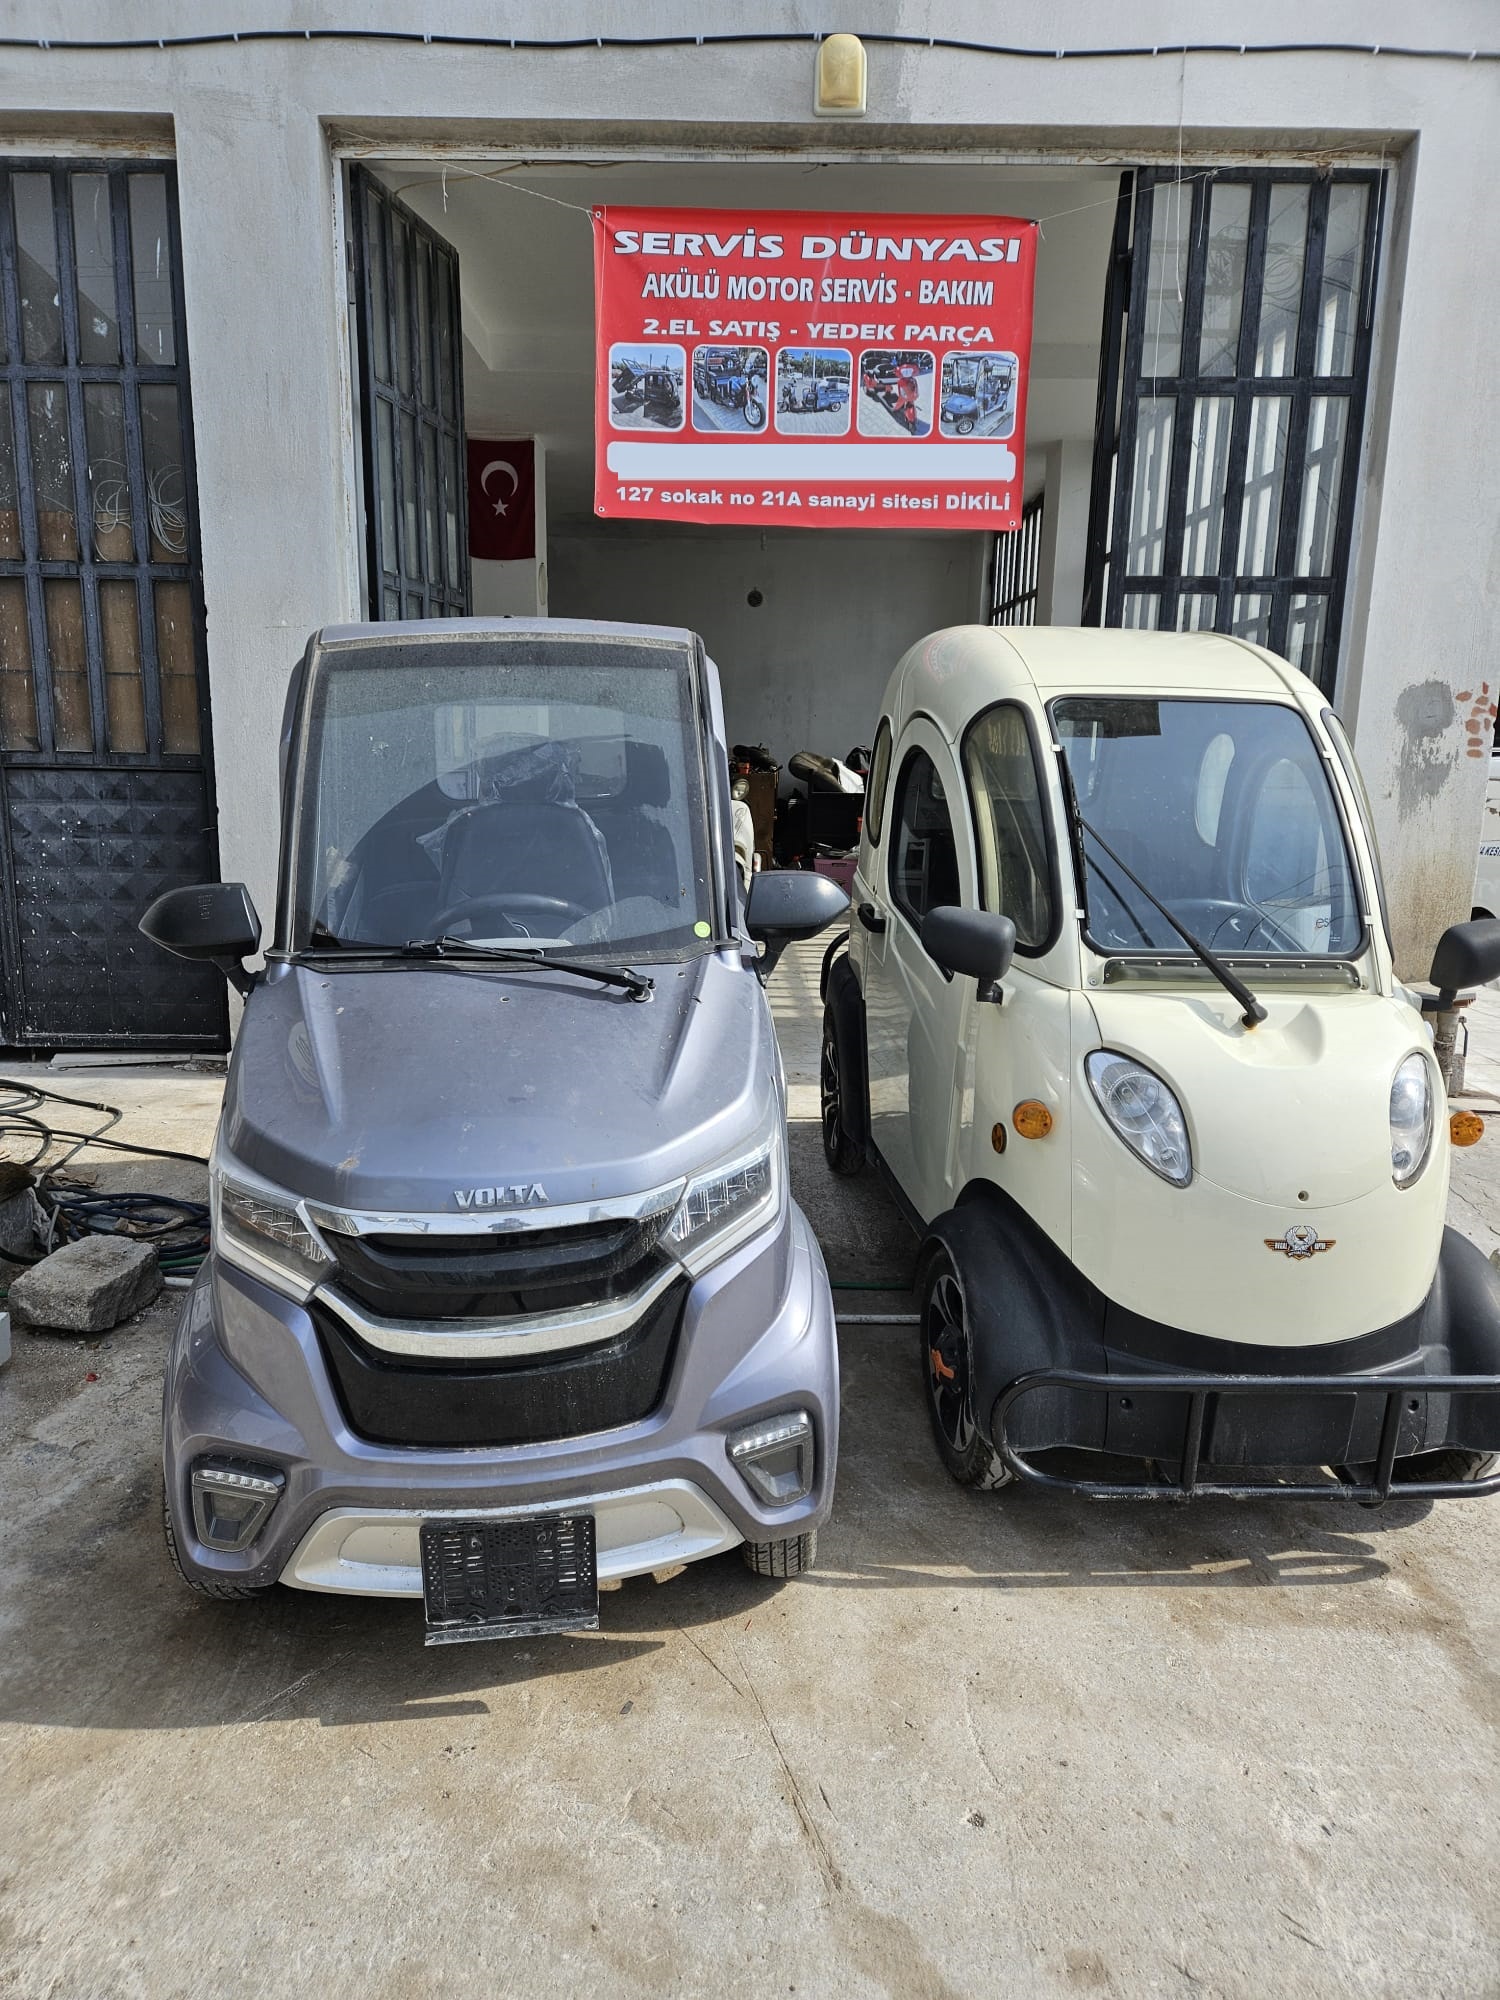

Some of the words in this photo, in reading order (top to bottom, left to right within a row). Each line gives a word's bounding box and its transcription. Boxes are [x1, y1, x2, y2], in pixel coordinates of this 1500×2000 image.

[613, 228, 784, 259] SERVİS
[801, 230, 1021, 263] DÜNYASI
[641, 267, 720, 299] AKÜLÜ
[727, 274, 814, 302] MOTOR
[820, 272, 898, 304] SERVİS
[918, 279, 994, 306] BAKIM
[642, 318, 700, 335] 2.EL
[708, 320, 780, 342] SATIŞ
[806, 322, 896, 340] YEDEK
[903, 325, 995, 346] PARÇA
[616, 486, 654, 502] 127
[660, 488, 724, 505] sokak
[730, 493, 755, 505] no
[761, 491, 802, 507] 21A
[808, 493, 876, 512] sanayi
[881, 493, 939, 510] sitesi
[946, 491, 1011, 512] DİKİLİ
[453, 1183, 550, 1210] VOLTA
